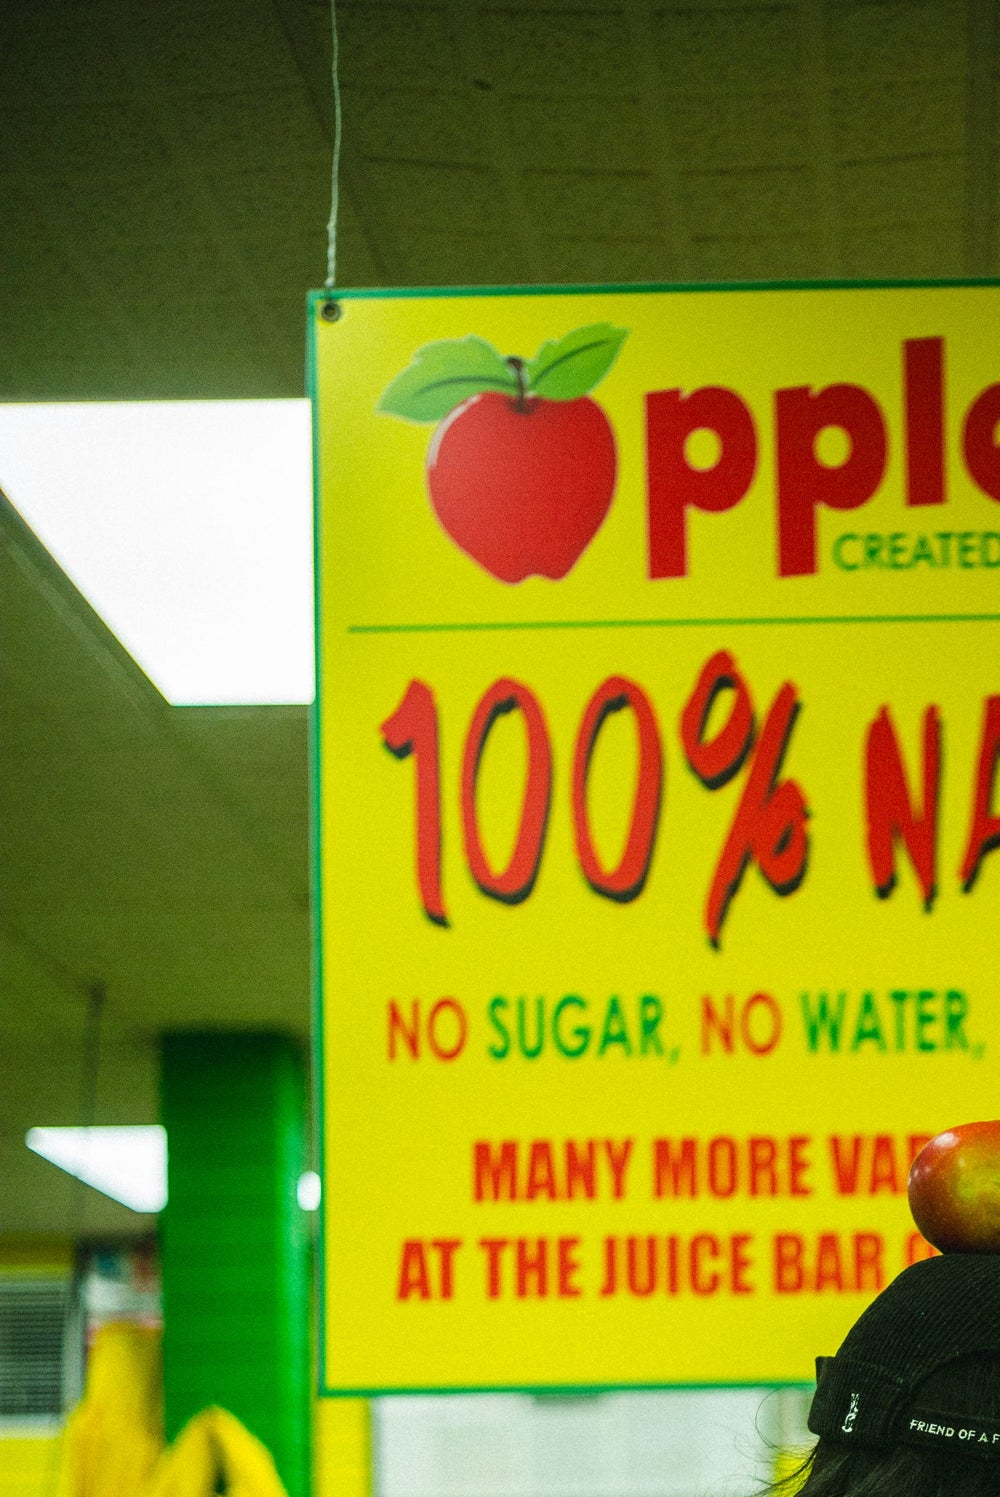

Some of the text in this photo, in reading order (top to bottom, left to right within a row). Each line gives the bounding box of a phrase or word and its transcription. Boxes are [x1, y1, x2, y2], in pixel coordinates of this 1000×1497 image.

[379, 649, 812, 950] 100%
[387, 997, 468, 1063] NO
[486, 991, 681, 1067] SUGAR,
[700, 991, 783, 1057] NO
[799, 988, 985, 1060] WATER,
[472, 1138, 634, 1204] MANY
[652, 1133, 813, 1200] MORE
[395, 1237, 463, 1303] AT
[478, 1234, 582, 1301] THE
[599, 1231, 756, 1300] JUICE
[772, 1229, 886, 1297] BAR
[910, 1419, 955, 1438] FRIEND
[958, 1428, 976, 1441] OF
[977, 1432, 989, 1443] A
